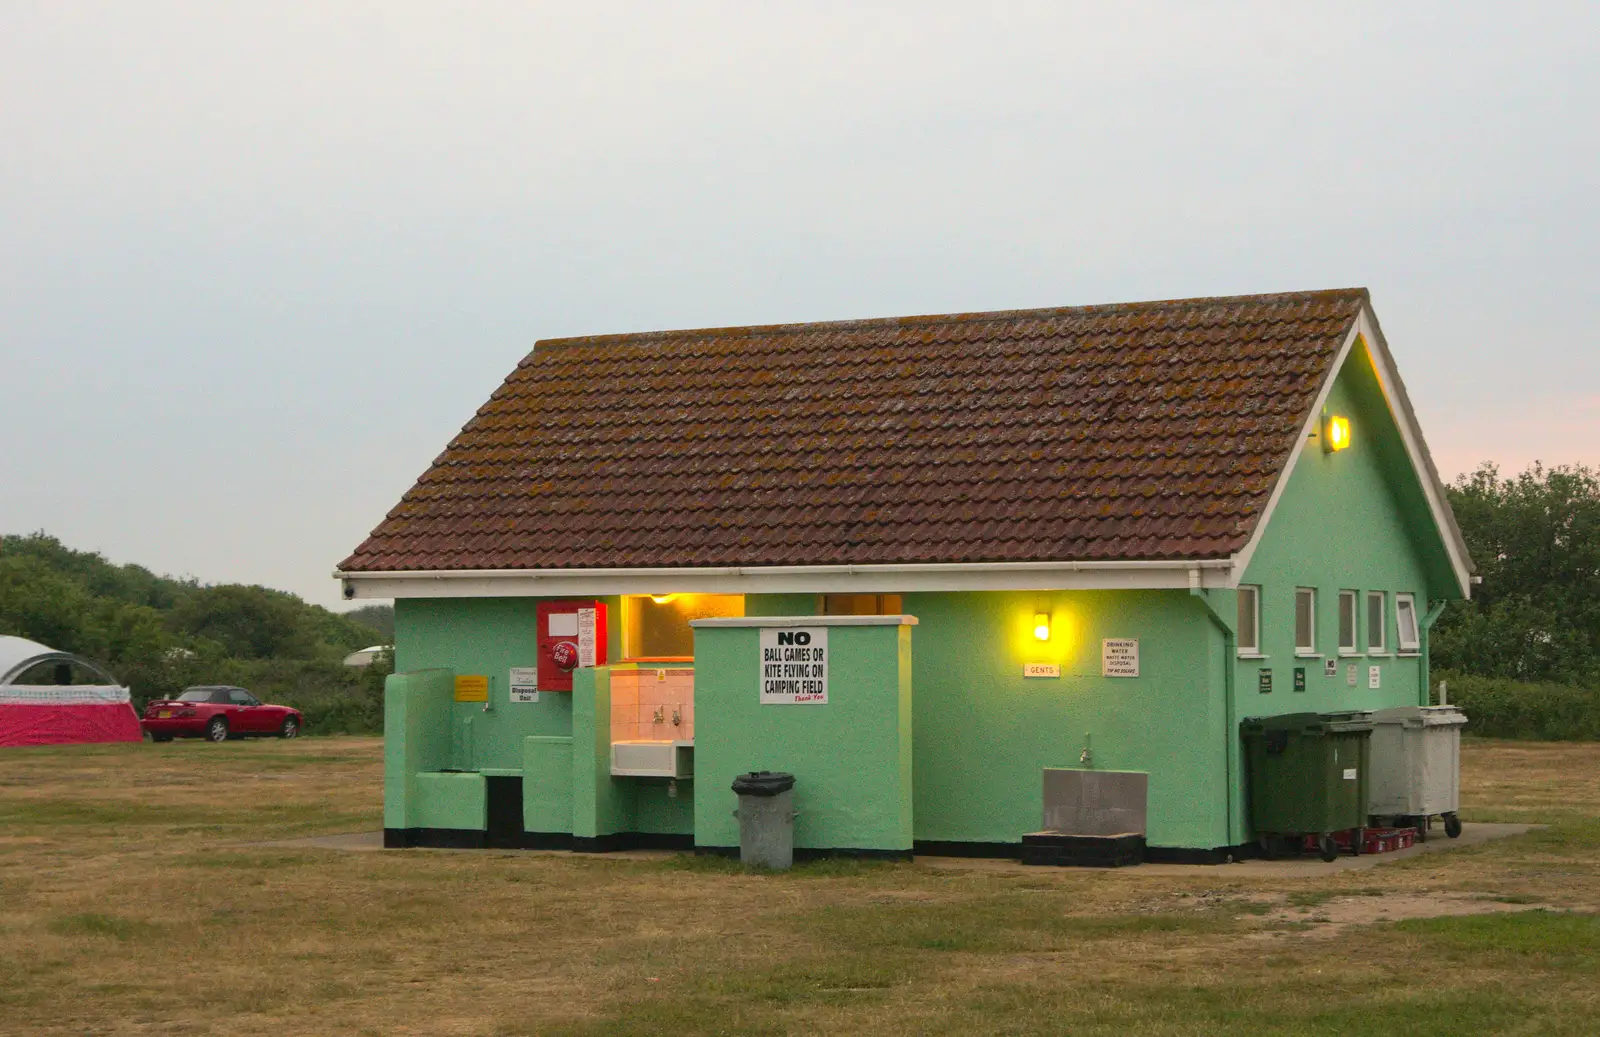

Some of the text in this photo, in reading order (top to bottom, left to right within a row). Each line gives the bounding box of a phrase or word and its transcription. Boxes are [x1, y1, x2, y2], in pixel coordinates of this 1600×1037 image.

[778, 632, 811, 645] NO
[556, 644, 569, 655] Fire
[764, 648, 824, 661] BALL GAMES OR
[554, 652, 568, 663] Bell
[764, 664, 824, 677] KITE FLYING ON
[1030, 666, 1054, 674] GENTS
[765, 680, 823, 694] CAMPING FIELD
